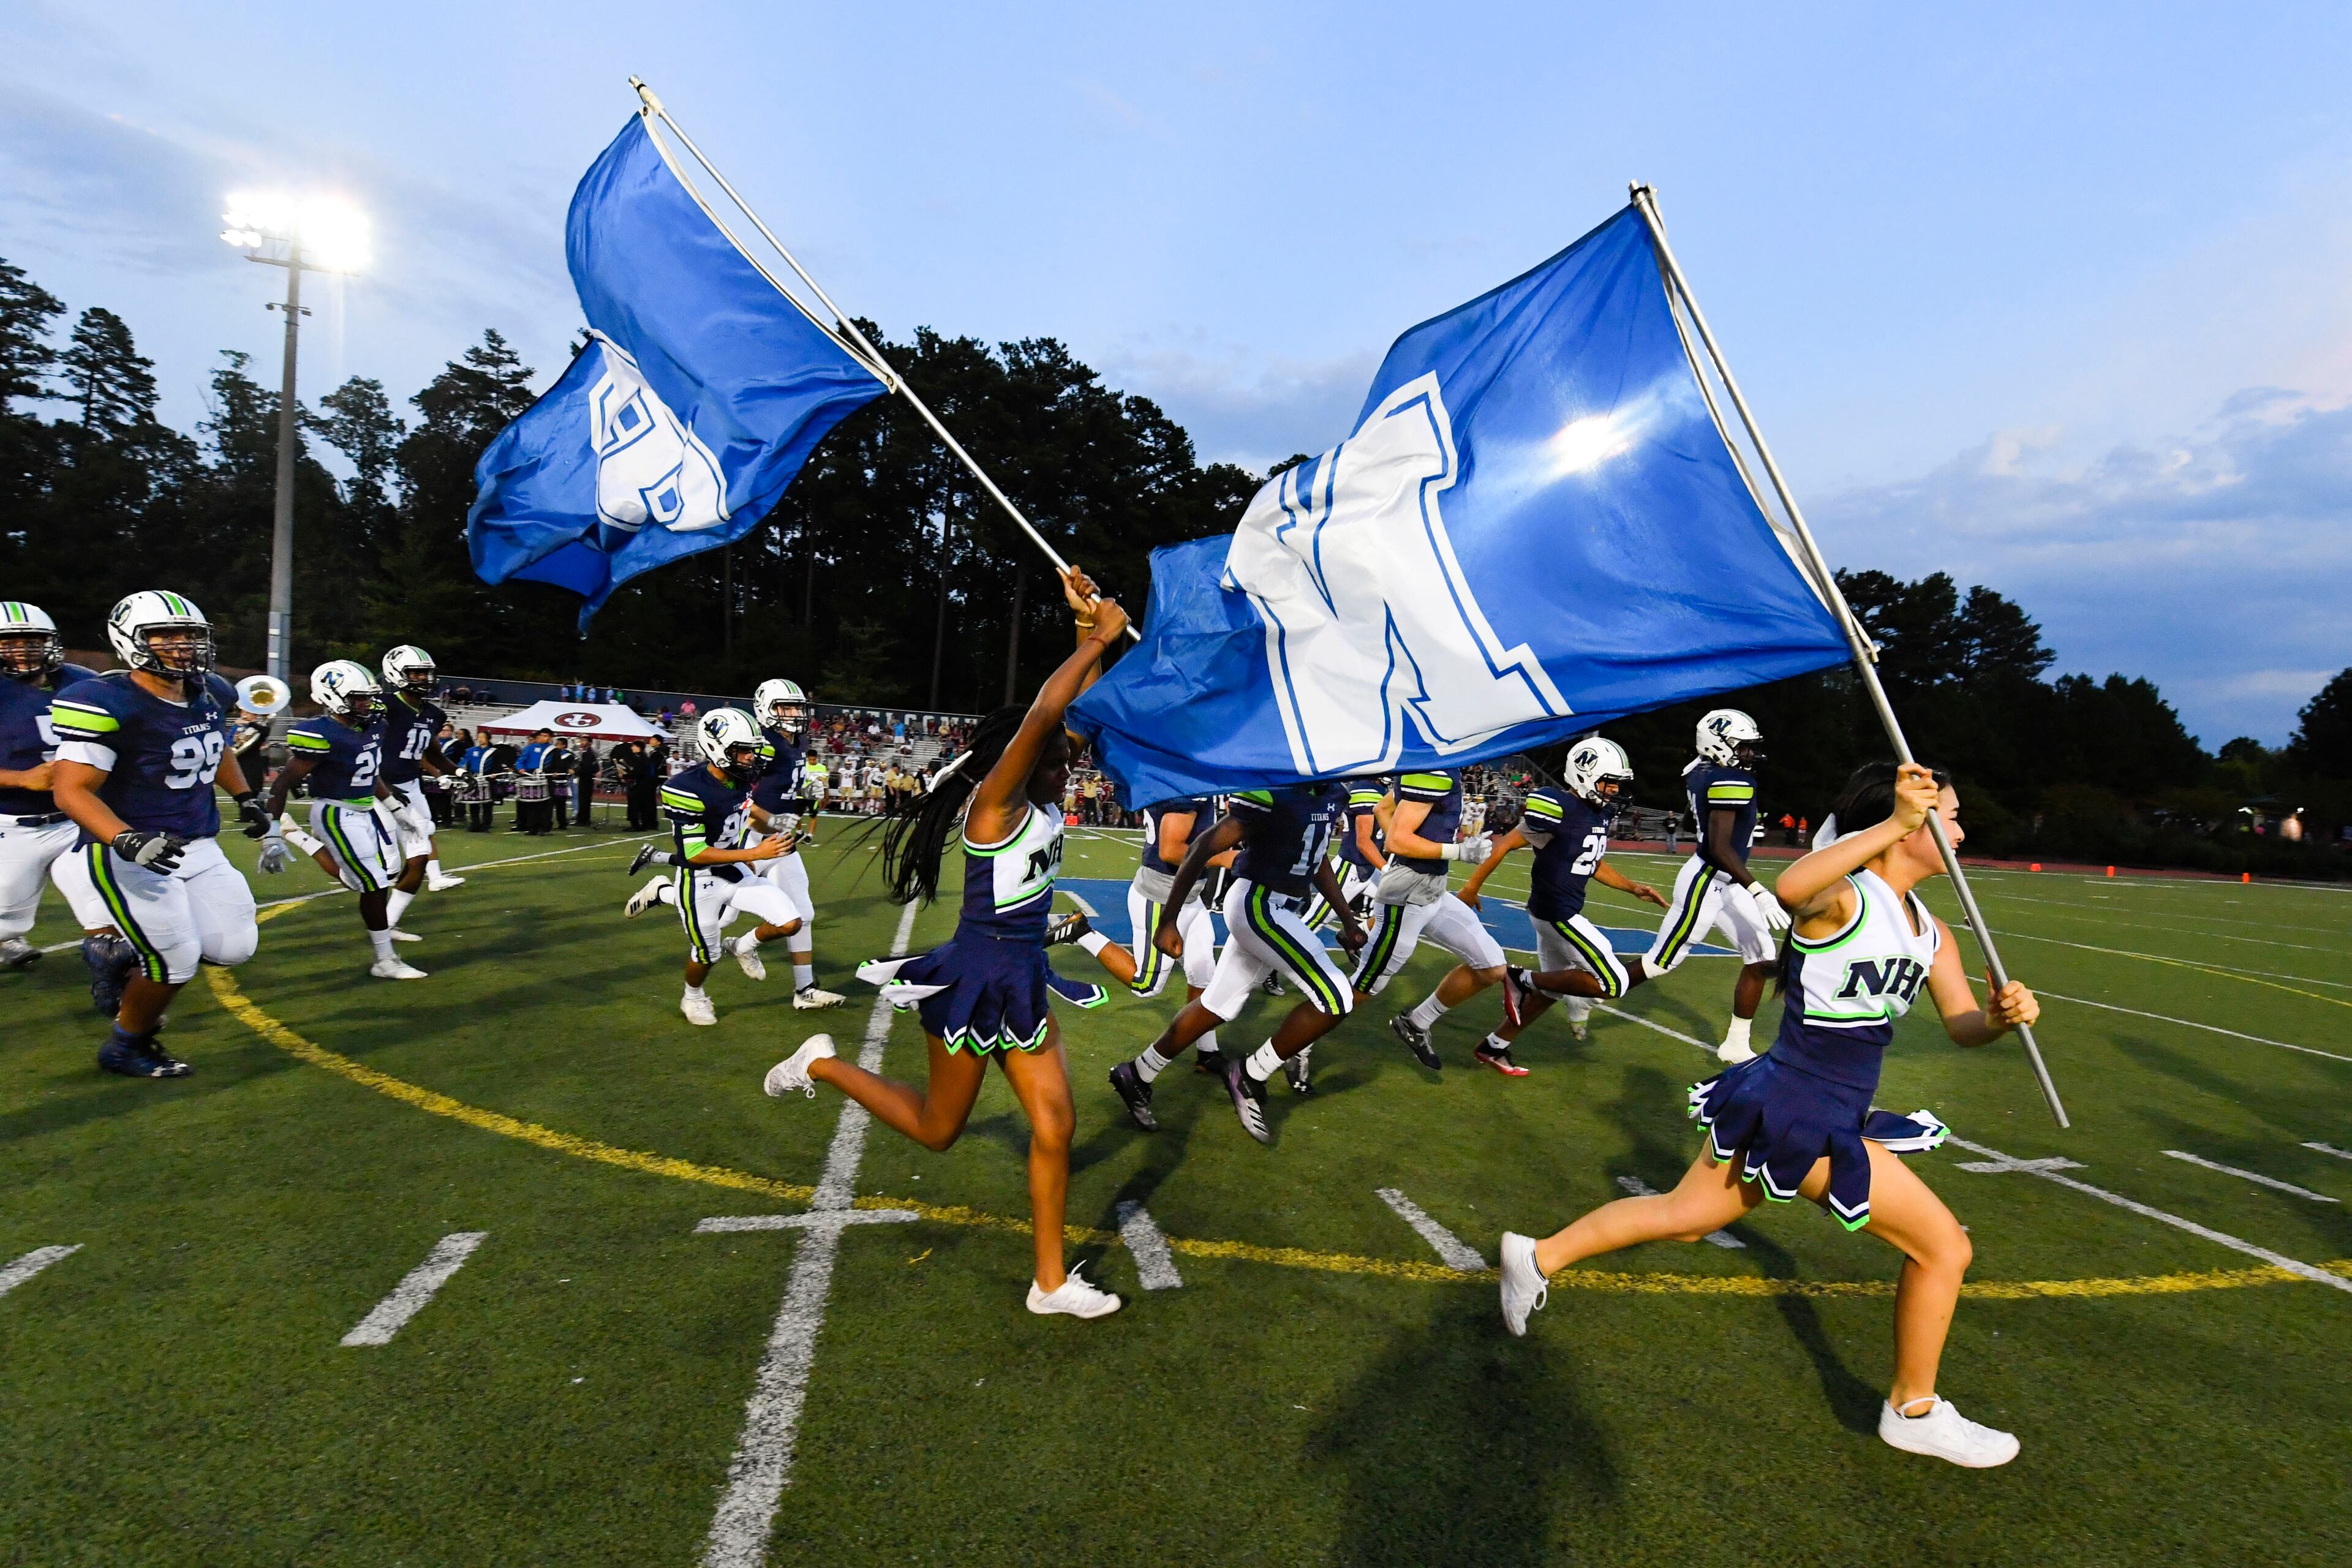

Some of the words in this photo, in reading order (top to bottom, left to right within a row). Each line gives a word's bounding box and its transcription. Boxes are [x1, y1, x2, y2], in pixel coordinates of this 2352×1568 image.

[182, 723, 211, 735] TITANS
[399, 728, 431, 760] 10
[164, 731, 225, 789] 99
[1311, 813, 1329, 821] TITANS
